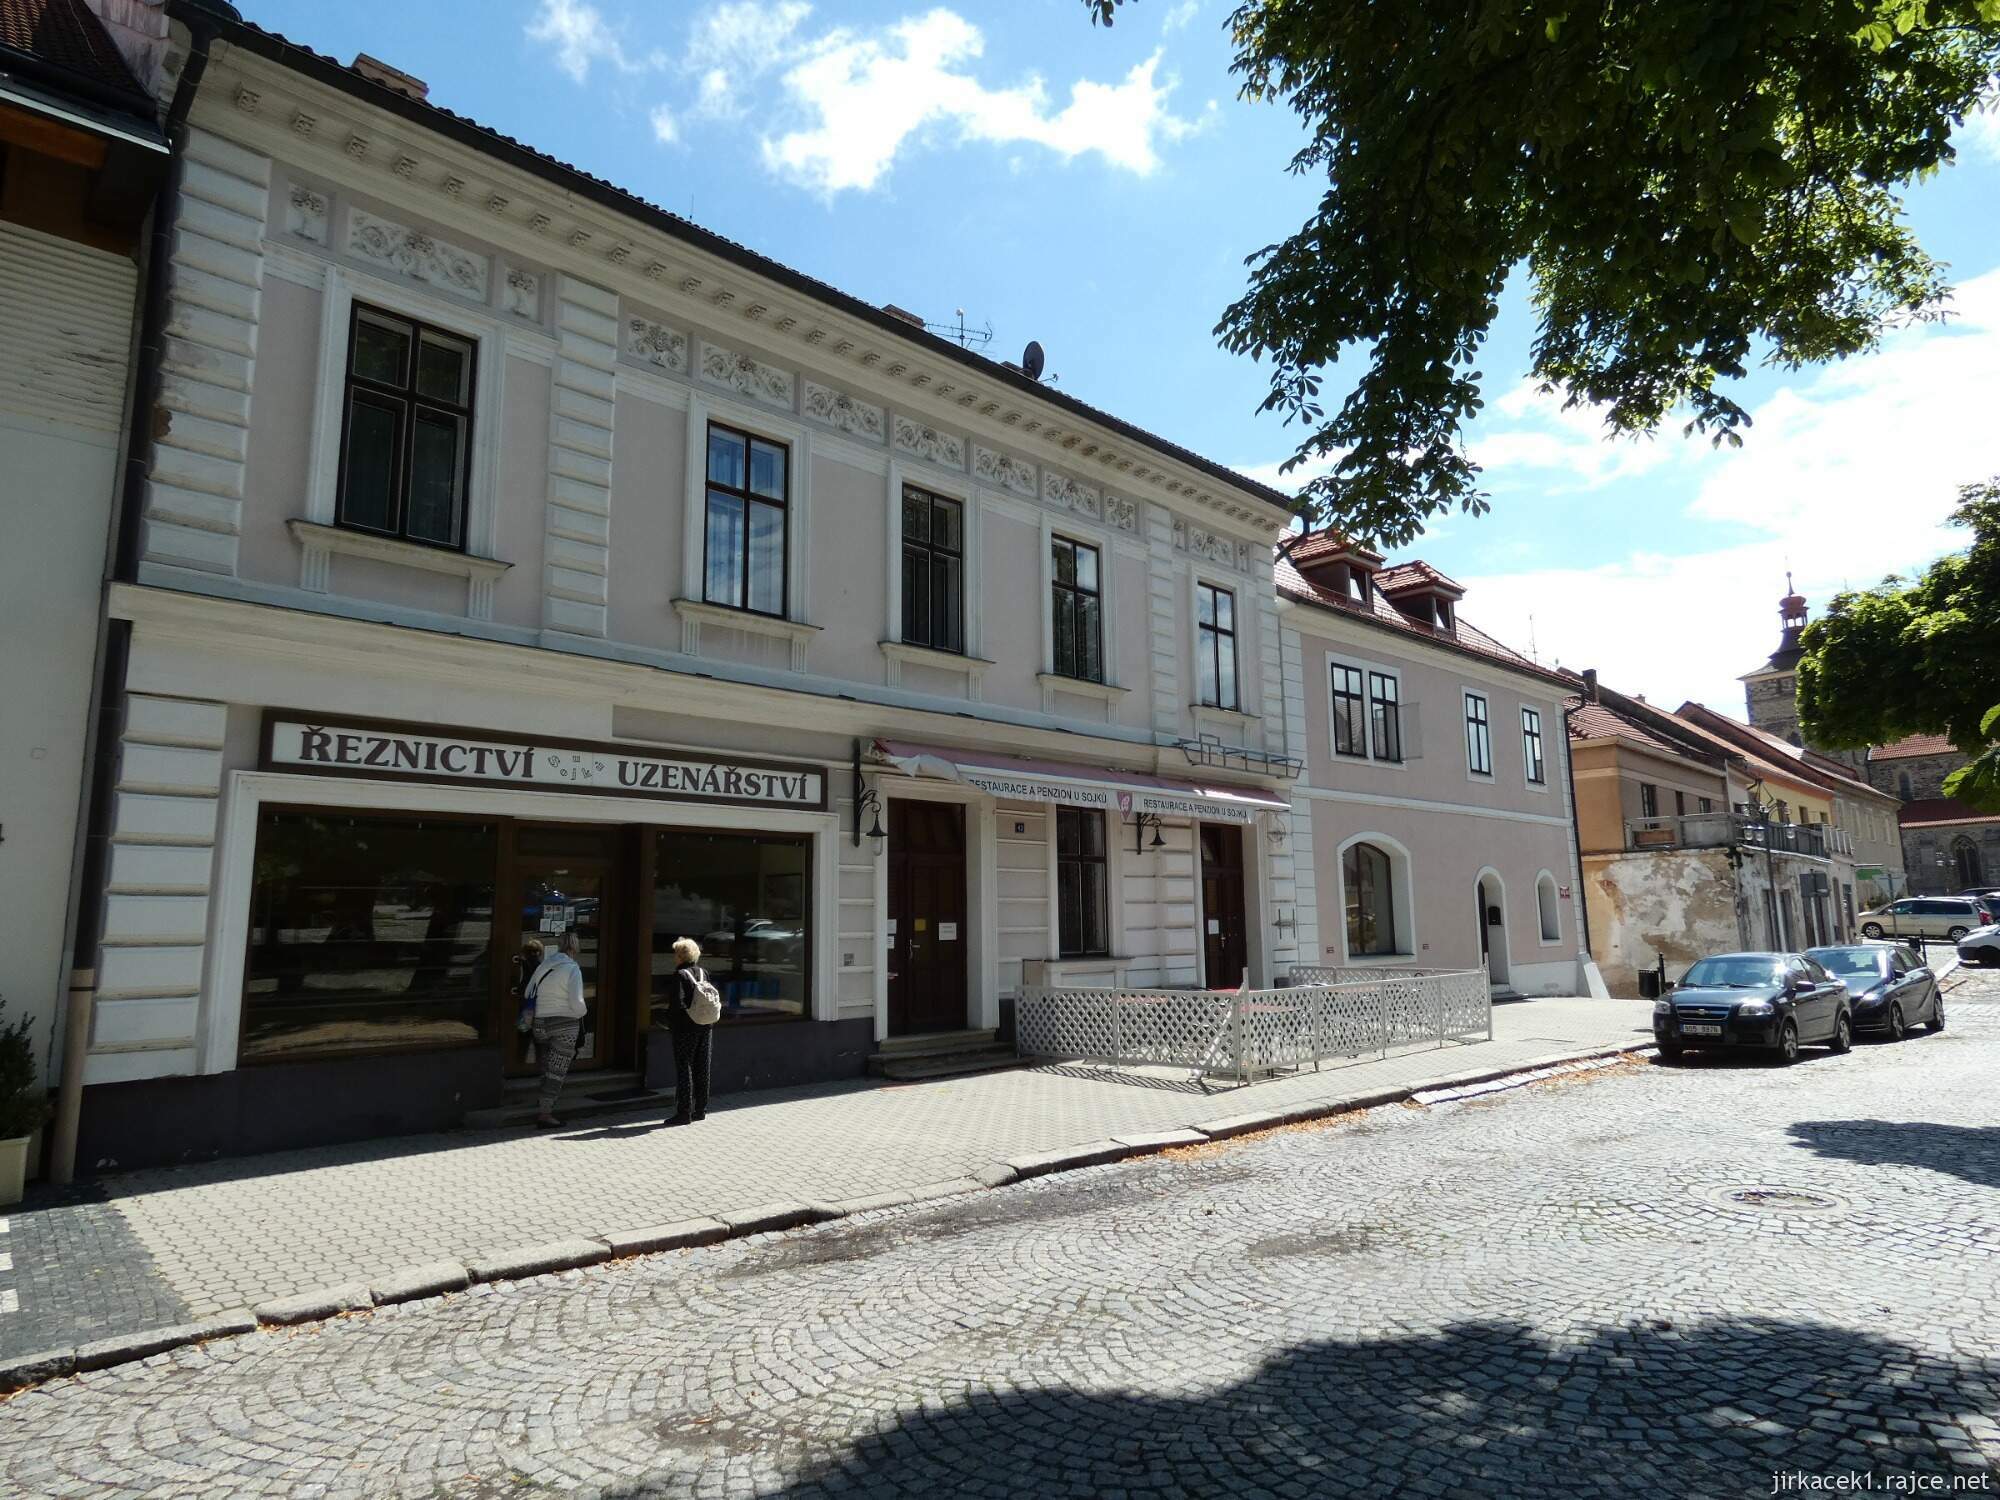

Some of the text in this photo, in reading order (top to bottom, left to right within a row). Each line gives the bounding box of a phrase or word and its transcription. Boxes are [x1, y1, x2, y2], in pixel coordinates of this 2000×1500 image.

[299, 726, 535, 778] ŘEZNICTVÍ
[618, 761, 807, 800] UZENÁŘSTVÍ
[968, 779, 1028, 795] ESTAURACE
[1029, 786, 1036, 796] A
[1037, 786, 1073, 800] PENZION
[1074, 791, 1080, 801] U
[1143, 798, 1188, 812] RESTAURACE
